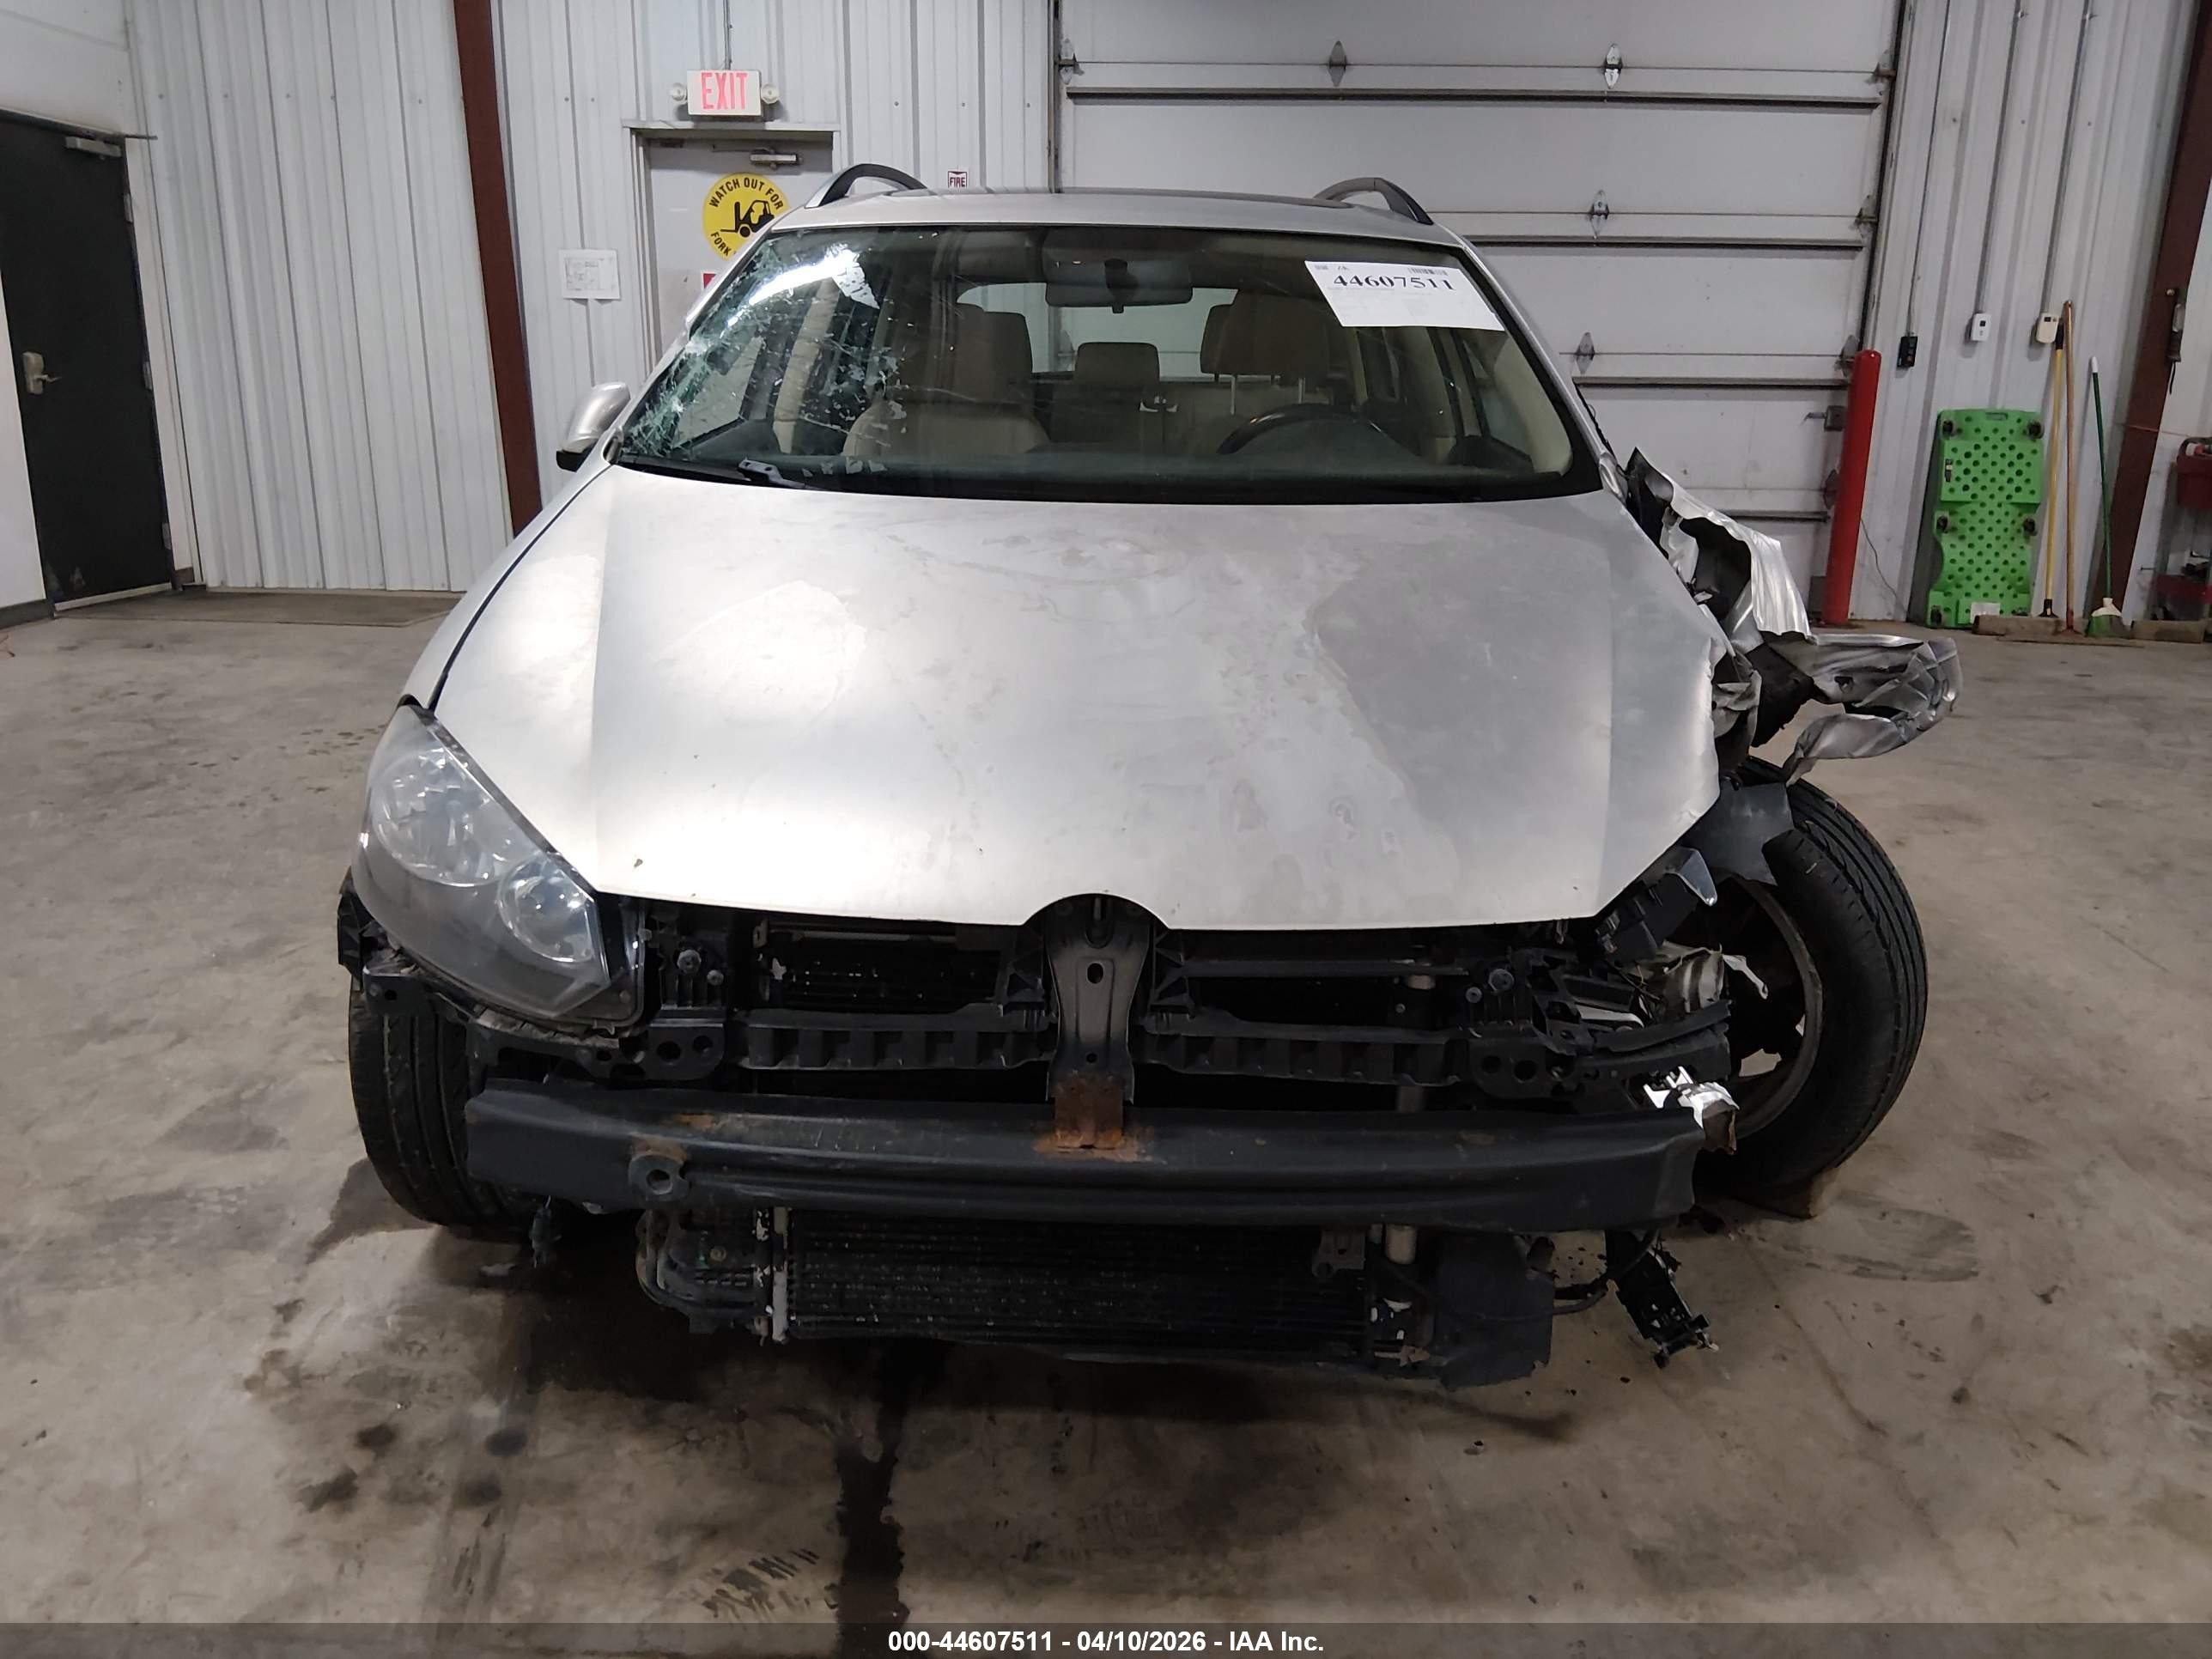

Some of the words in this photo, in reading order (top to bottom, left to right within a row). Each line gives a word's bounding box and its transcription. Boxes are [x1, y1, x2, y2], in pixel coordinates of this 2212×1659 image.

[701, 72, 748, 110] EXIT
[708, 179, 740, 208] WATCH
[744, 177, 765, 191] OUT
[765, 188, 783, 210] FOR
[949, 177, 966, 187] FIRE
[711, 232, 732, 256] FORK
[1334, 275, 1455, 290] 44607511
